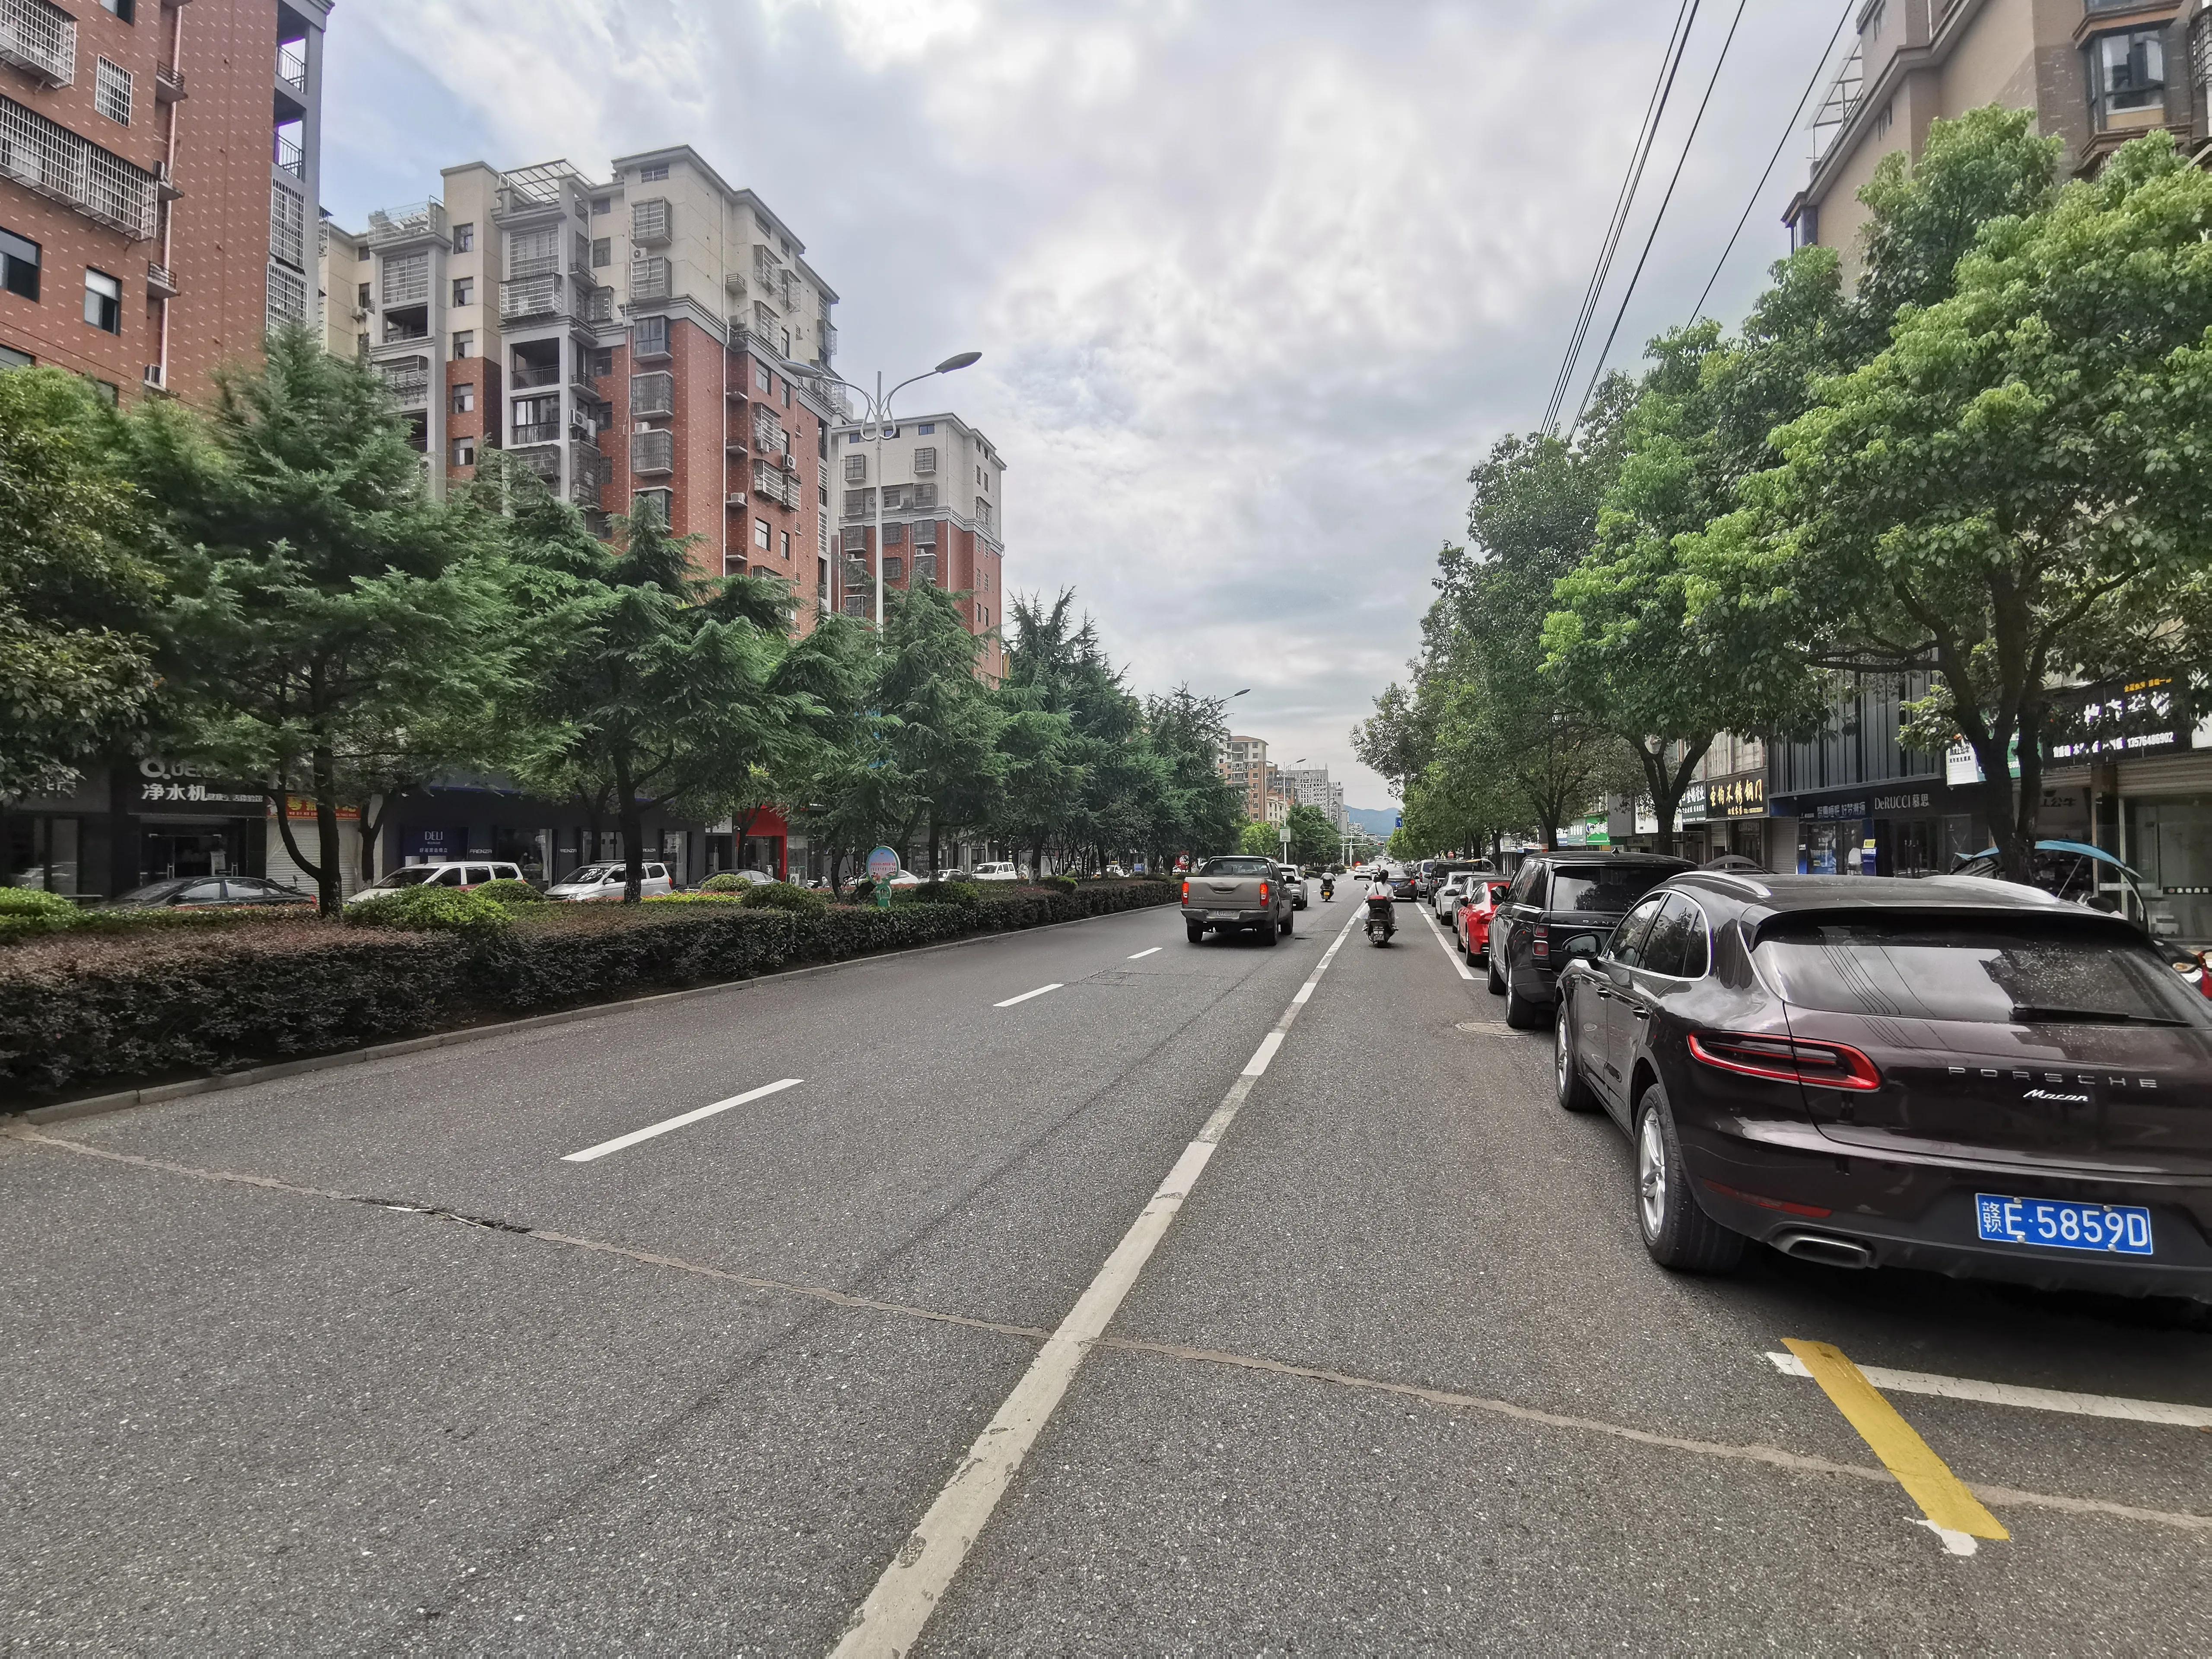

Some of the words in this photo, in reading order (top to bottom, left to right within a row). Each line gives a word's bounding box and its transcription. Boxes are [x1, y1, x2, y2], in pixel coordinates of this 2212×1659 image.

[141, 783, 208, 801] 净水机
[1875, 795, 1910, 810] DeRUCCI
[1912, 794, 1929, 808] 慕思
[425, 831, 443, 840] DELI
[1948, 1066, 2158, 1089] PORSCHE
[2023, 1089, 2089, 1102] Macan
